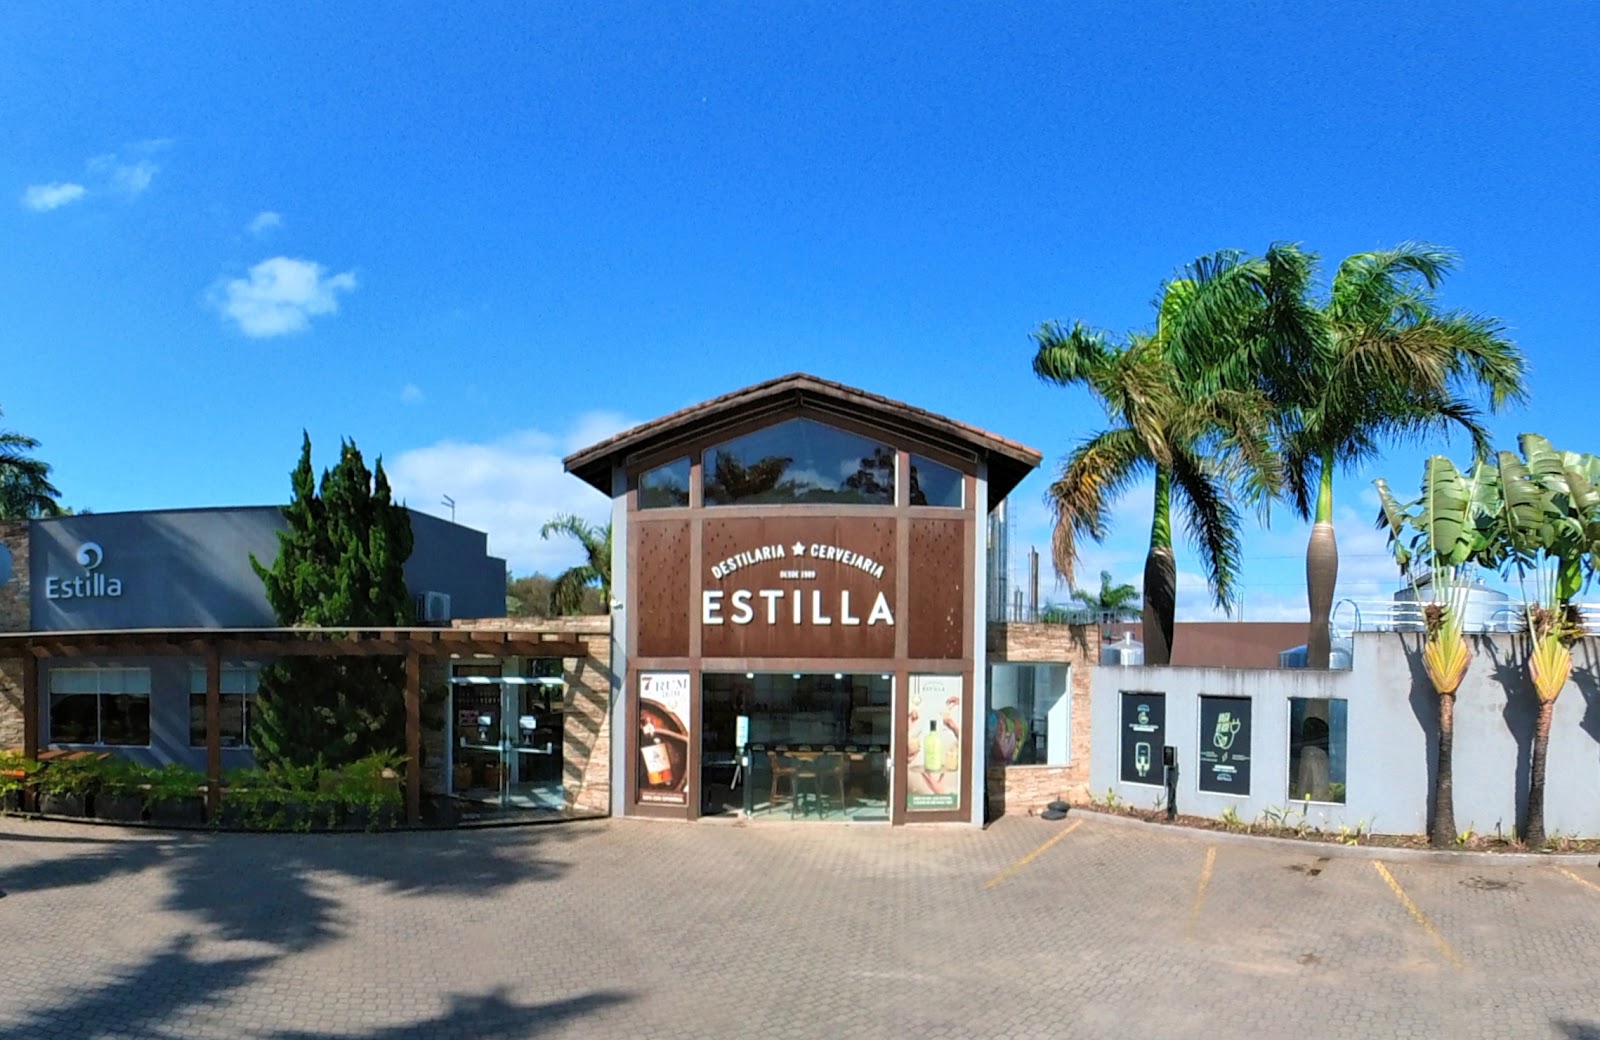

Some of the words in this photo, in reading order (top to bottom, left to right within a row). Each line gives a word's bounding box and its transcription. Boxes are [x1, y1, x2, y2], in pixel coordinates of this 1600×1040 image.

[711, 544, 786, 580] DESTILARIA
[810, 543, 884, 579] CERVEJARIA
[45, 572, 122, 599] Estilla
[702, 589, 895, 626] ESTILLA
